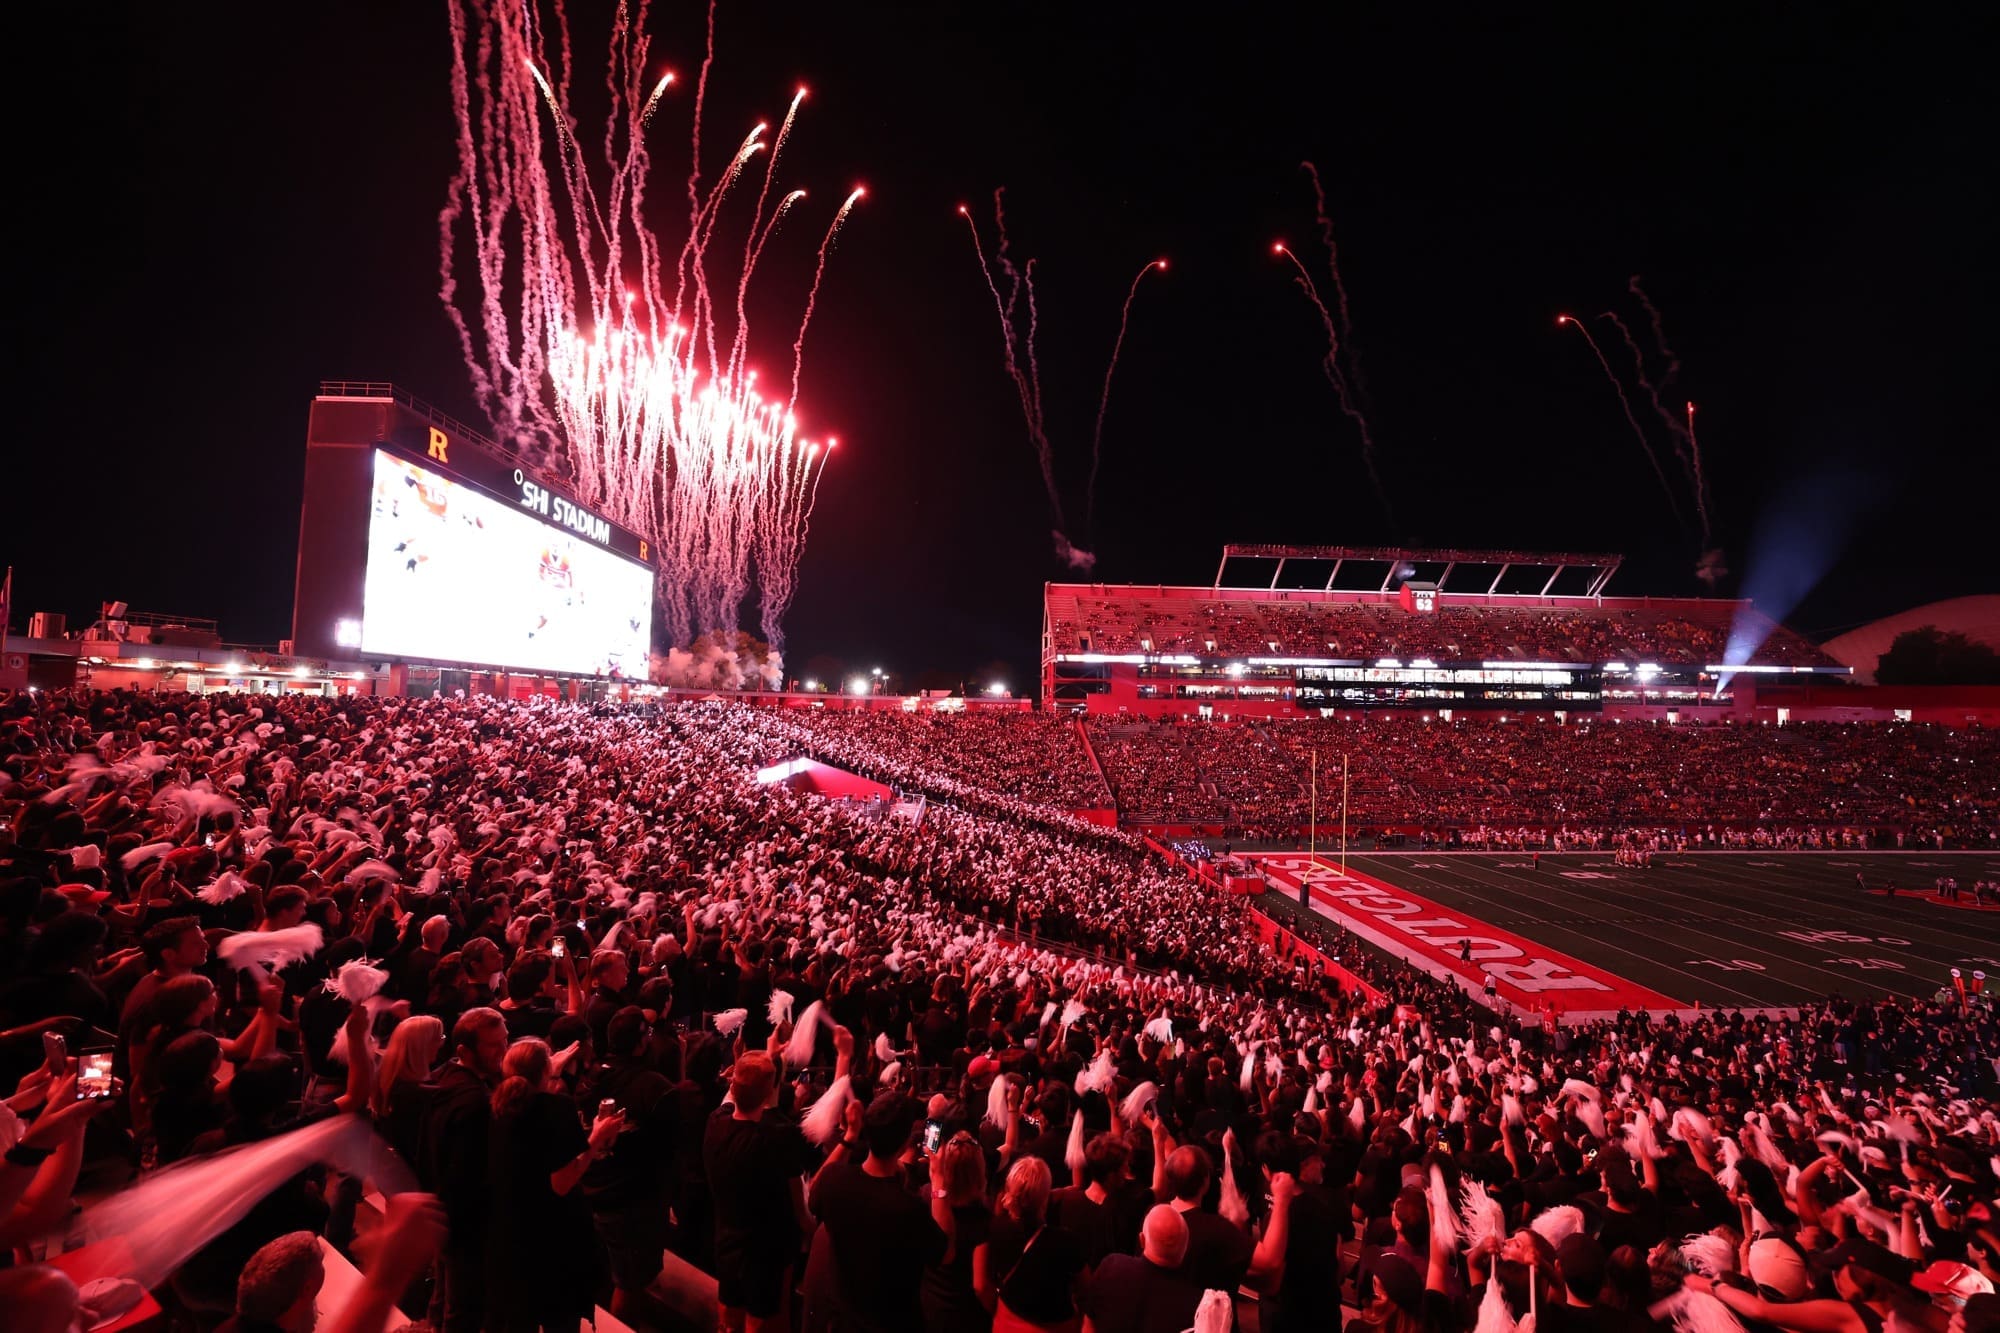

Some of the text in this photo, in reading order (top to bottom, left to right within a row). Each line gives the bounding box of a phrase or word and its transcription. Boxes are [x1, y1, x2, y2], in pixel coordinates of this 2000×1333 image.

[428, 427, 449, 464] R
[521, 481, 549, 515] SHI
[553, 497, 610, 545] STADIUM
[640, 540, 648, 561] R
[1267, 859, 1614, 993] RUTGERS
[1699, 959, 1767, 971] 10
[1838, 958, 1906, 969] 20
